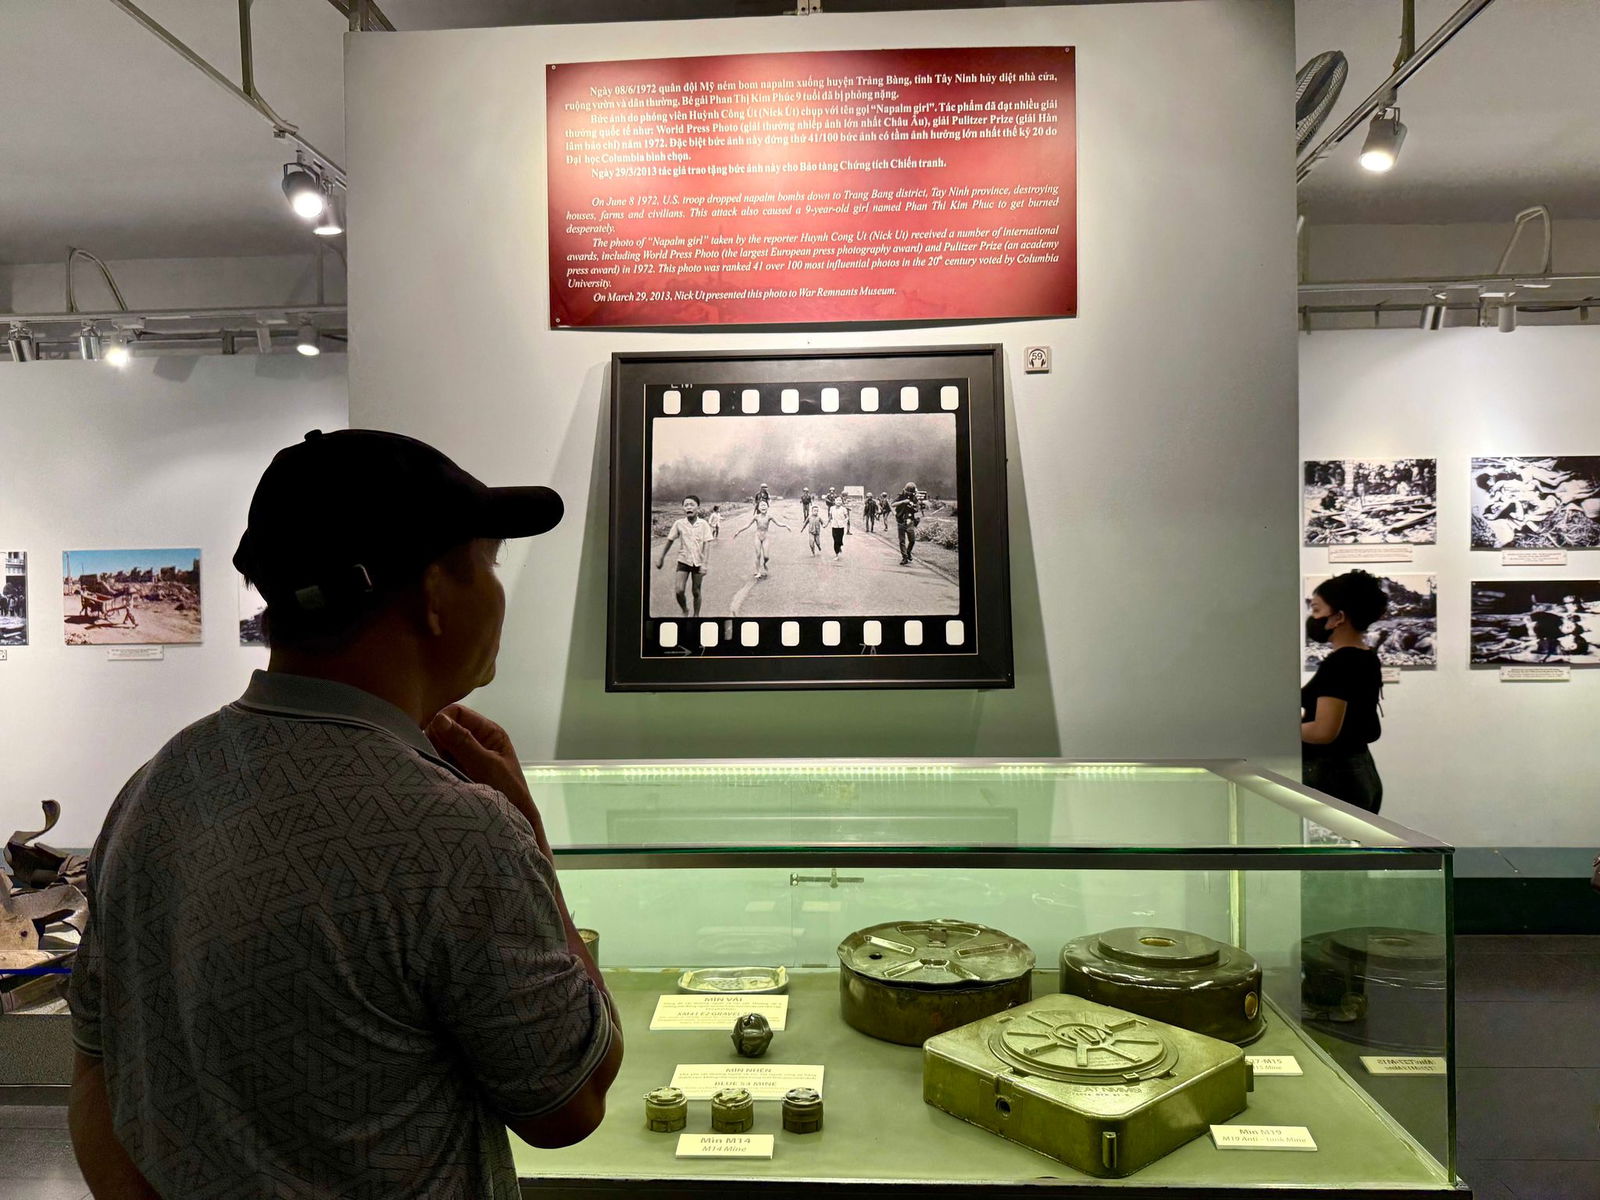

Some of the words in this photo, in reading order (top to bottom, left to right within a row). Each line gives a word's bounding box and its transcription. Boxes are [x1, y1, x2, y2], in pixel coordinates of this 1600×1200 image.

[738, 80, 758, 90] bom
[761, 78, 794, 91] napalm
[955, 73, 977, 83] Ninh
[710, 94, 732, 104] Phan
[751, 93, 770, 103] Kim
[796, 92, 802, 101] 9
[656, 124, 684, 135] World
[687, 123, 710, 134] Press
[713, 122, 738, 133] Photo
[952, 115, 988, 125] Pulitzer
[990, 114, 1014, 124] Prize
[645, 138, 668, 149] 1972.
[1032, 127, 1044, 136] 20
[601, 152, 645, 164] Columbia
[688, 166, 707, 175] trao
[919, 157, 947, 168] tranh.
[592, 197, 605, 207] On
[606, 196, 627, 206] June
[629, 196, 635, 206] 8
[663, 194, 680, 205] U.S.
[683, 196, 705, 207] troop
[707, 192, 742, 206] dropped
[744, 192, 775, 205] napalm
[778, 191, 805, 202] bombs
[807, 191, 830, 201] down
[832, 192, 842, 200] to
[844, 189, 869, 202] Trang
[871, 188, 894, 201] Bang
[896, 187, 928, 199] district,
[932, 187, 947, 199] Tay
[949, 185, 970, 197] Ninh
[1014, 183, 1059, 197] destroying
[600, 210, 624, 222] farms
[628, 209, 645, 219] and
[690, 207, 708, 218] This
[712, 206, 738, 217] attack
[741, 206, 759, 217] also
[762, 205, 793, 216] caused
[806, 203, 850, 217] 9-year-old
[852, 202, 870, 216] girl
[872, 202, 902, 213] named
[905, 201, 928, 211] Phan
[932, 200, 946, 211] Thi
[950, 199, 968, 210] Kim
[972, 199, 994, 209] Phuc
[998, 200, 1007, 209] to
[1010, 200, 1025, 211] get
[1028, 196, 1060, 208] burned
[566, 223, 615, 236] desperately.
[593, 238, 608, 248] The
[609, 237, 634, 250] photo
[636, 237, 646, 249] of
[711, 234, 734, 245] taken
[736, 234, 747, 246] by
[748, 233, 762, 244] the
[764, 234, 798, 246] reporter
[800, 232, 829, 244] Huynh
[831, 231, 854, 244] Cong
[856, 231, 867, 241] Ut
[869, 230, 893, 242] (Nick
[895, 229, 909, 242] Ut)
[911, 228, 948, 239] received
[957, 227, 990, 238] number
[992, 227, 1002, 239] of
[567, 251, 599, 262] awards,
[602, 250, 641, 263] including
[644, 249, 668, 260] World
[670, 249, 692, 259] Press
[694, 248, 720, 259] Photo
[721, 248, 738, 260] (the
[740, 247, 769, 260] largest
[771, 246, 811, 259] European
[812, 248, 835, 258] press
[837, 244, 891, 257] photography
[893, 243, 923, 255] award)
[925, 242, 942, 252] and
[944, 241, 978, 252] Pulitzer
[980, 240, 1002, 251] Prize
[1004, 240, 1019, 251] (an
[1021, 239, 1059, 251] academy
[566, 268, 589, 277] press
[590, 264, 620, 276] award)
[622, 265, 631, 274] in
[659, 263, 676, 274] This
[677, 262, 702, 275] photo
[722, 261, 752, 272] ranked
[753, 261, 763, 271] 41
[788, 260, 803, 270] 100
[804, 261, 825, 270] most
[826, 258, 870, 271] influential
[871, 257, 900, 270] photos
[902, 258, 911, 267] in
[912, 256, 926, 267] the
[945, 257, 977, 268] century
[979, 254, 1003, 265] voted
[1004, 254, 1015, 266] by
[1017, 253, 1059, 264] Columbia
[568, 279, 611, 290] University.
[593, 292, 606, 302] On
[607, 292, 634, 302] March
[674, 290, 694, 301] Nick
[695, 290, 706, 300] Ut
[705, 289, 747, 302] presented
[747, 289, 763, 299] this
[763, 288, 788, 301] photo
[788, 290, 798, 298] to
[799, 288, 816, 297] War
[817, 287, 858, 297] Remnants
[859, 286, 897, 296] Museum.
[1032, 352, 1043, 360] 59
